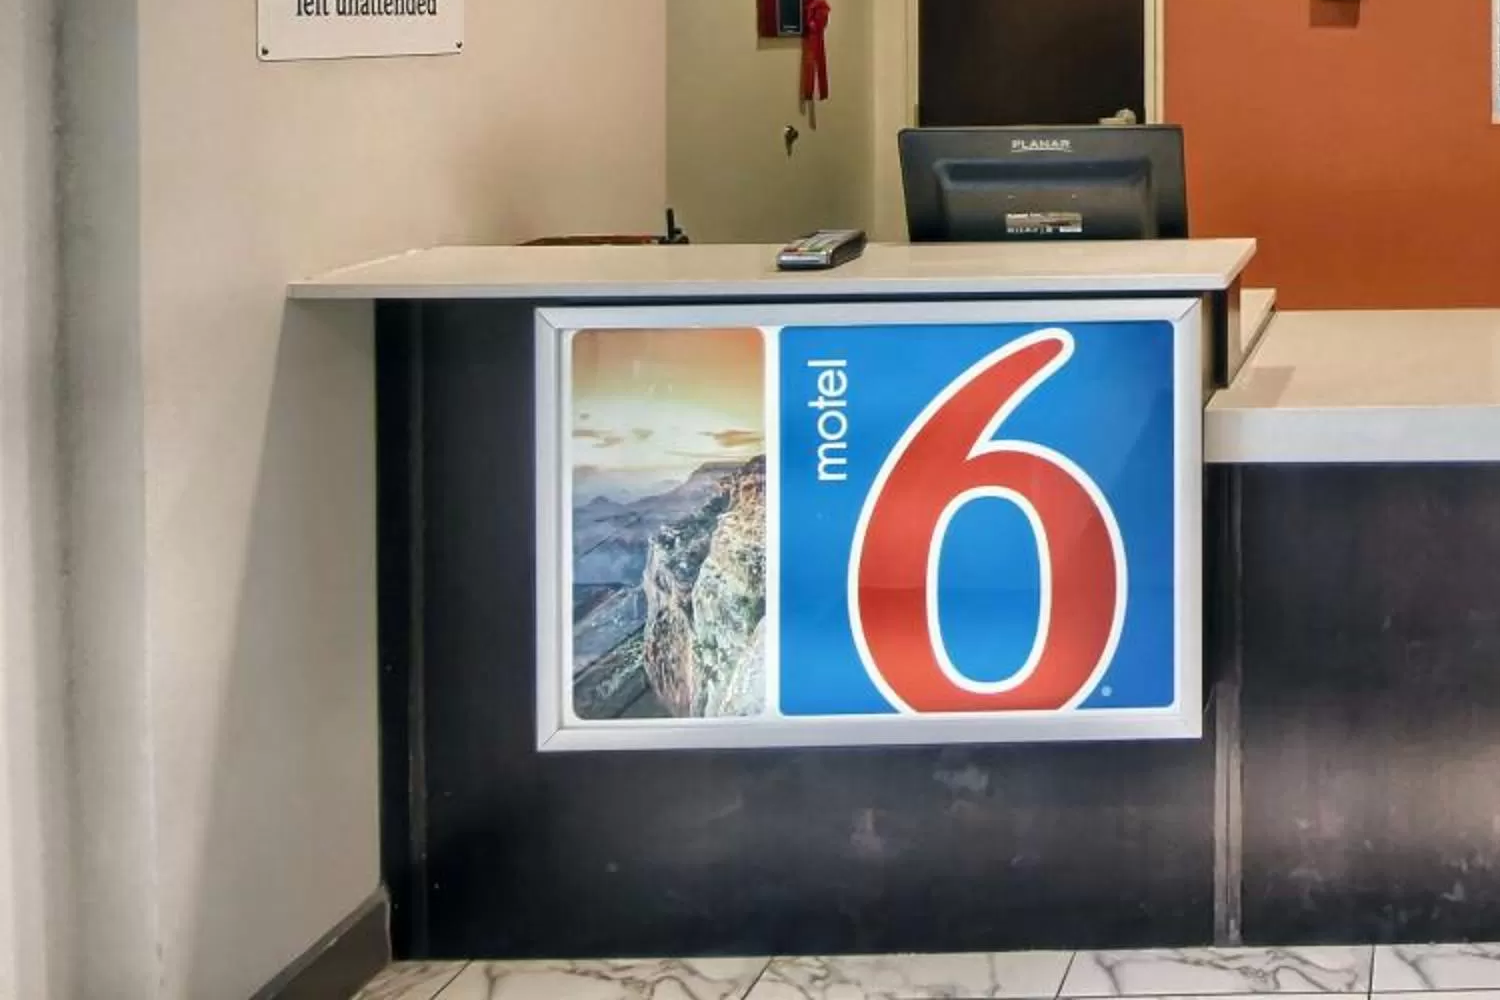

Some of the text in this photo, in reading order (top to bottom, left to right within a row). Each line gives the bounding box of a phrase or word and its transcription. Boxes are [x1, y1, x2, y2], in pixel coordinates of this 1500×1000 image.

[1010, 138, 1072, 151] PLANAR
[807, 358, 848, 483] motel
[846, 327, 1128, 714] 6
